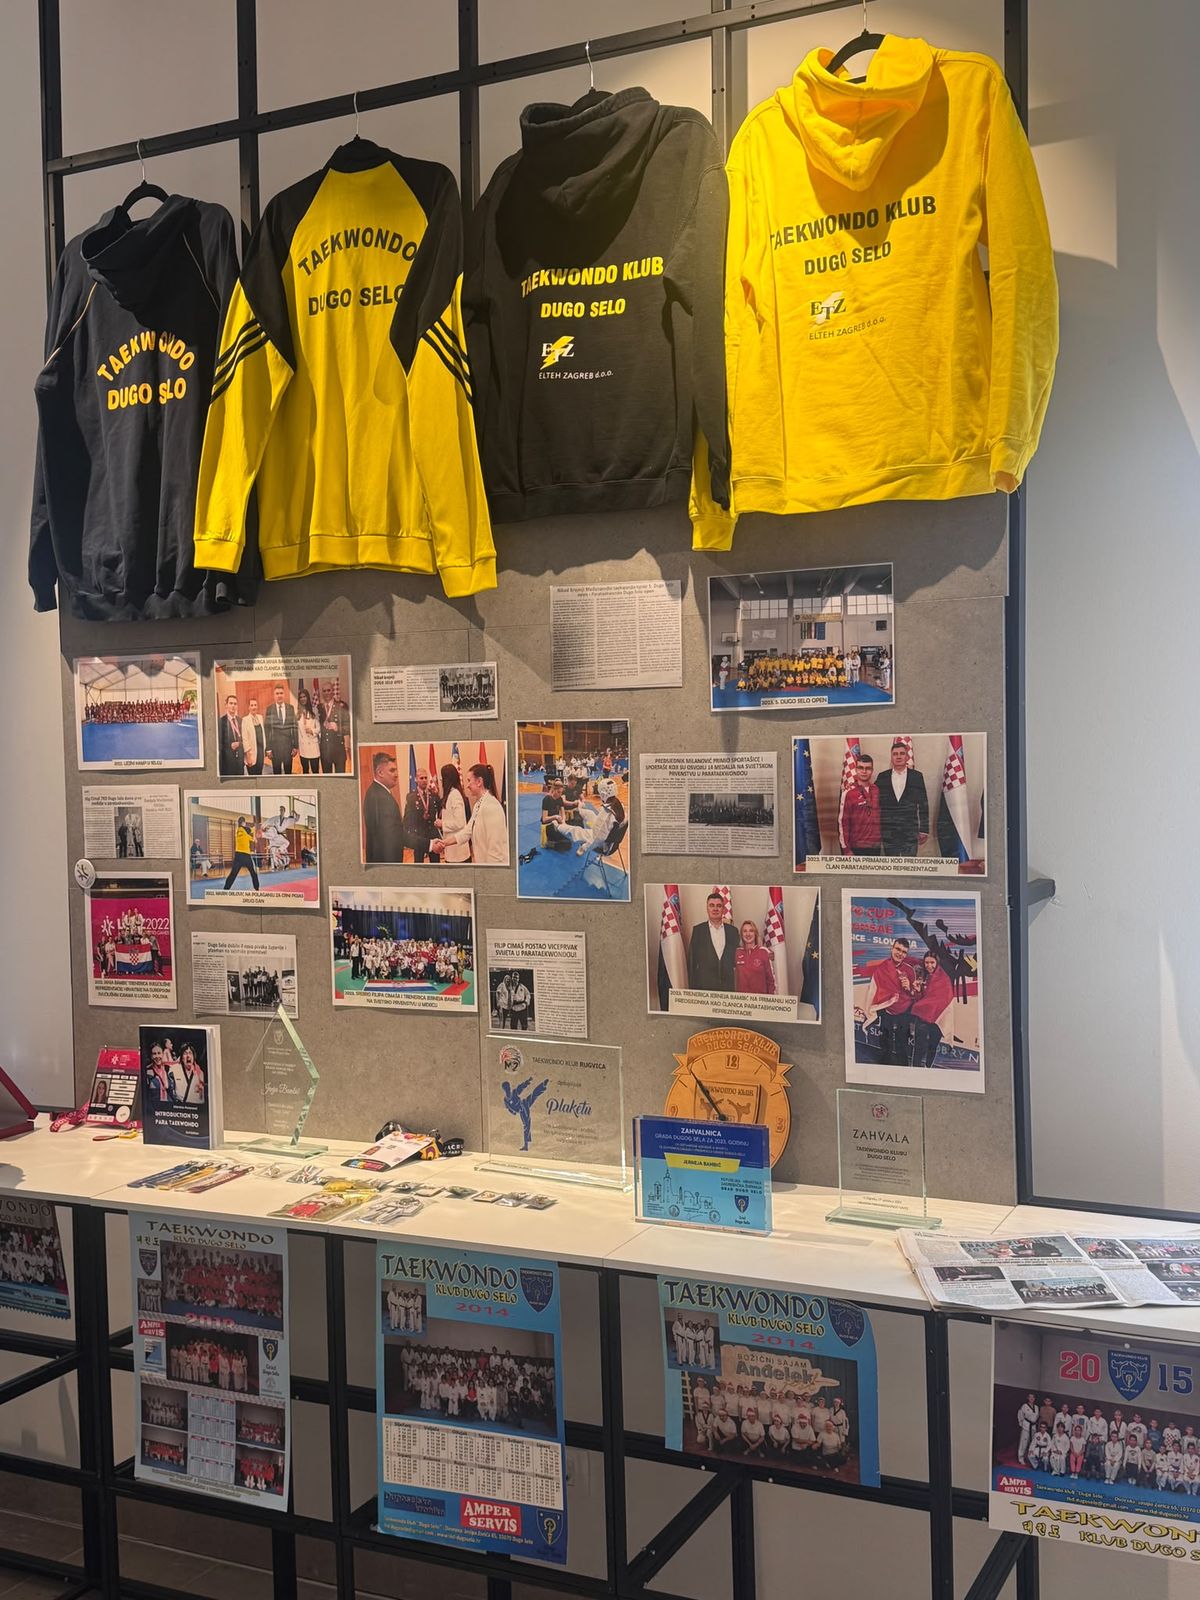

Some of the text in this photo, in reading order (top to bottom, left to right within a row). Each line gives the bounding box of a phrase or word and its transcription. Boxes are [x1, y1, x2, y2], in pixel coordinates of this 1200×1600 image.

[885, 196, 936, 223] KLUB
[298, 227, 417, 277] TAEKWONDO
[804, 241, 892, 275] DUGO SELO
[521, 256, 664, 298] TAEKWONDO KLUB
[309, 288, 351, 316] DUGO
[540, 298, 626, 318] DUGO SELO
[810, 298, 846, 320] ETZ
[809, 330, 835, 340] ELTEH
[836, 322, 866, 337] ZAGREB
[538, 371, 561, 380] ELTEH
[562, 371, 594, 380] ZAGREB
[108, 377, 186, 410] DUGO SLO
[867, 906, 897, 919] CUP
[146, 917, 169, 930] 2022
[547, 943, 578, 951] VICEPRVAK
[872, 936, 917, 948] SLOVA
[706, 1039, 733, 1051] DUGO
[532, 1056, 564, 1066] TAEKWONDO
[579, 1061, 606, 1069] RUGVICA
[726, 1054, 737, 1068] 12
[155, 1111, 191, 1119] INTRODUCTION
[546, 1098, 592, 1119] Plaketu
[169, 1119, 199, 1128] TAEKWONDO
[775, 1115, 786, 1133] 3
[680, 1127, 722, 1138] ZAHVALNICA
[852, 1128, 910, 1145] ZAHVALA
[856, 1145, 889, 1155] TAEKWONDO
[146, 1220, 274, 1246] TAEKWONDO
[381, 1253, 518, 1290] TAEKWONDO
[493, 1291, 517, 1304] SELO
[664, 1280, 825, 1321] TAEKWONDO
[456, 1302, 510, 1317] 2014
[795, 1322, 825, 1337] SELO
[751, 1332, 815, 1350] 2014
[777, 1359, 807, 1369] SAJAM
[1059, 1350, 1194, 1395] 20 15
[1000, 1475, 1027, 1487] AMPER
[1004, 1485, 1032, 1496] SERVIS
[464, 1501, 511, 1516] AMPER
[469, 1516, 517, 1533] SERVIS
[1010, 1500, 1200, 1543] TAEKWON
[1022, 1520, 1060, 1539] 태권도
